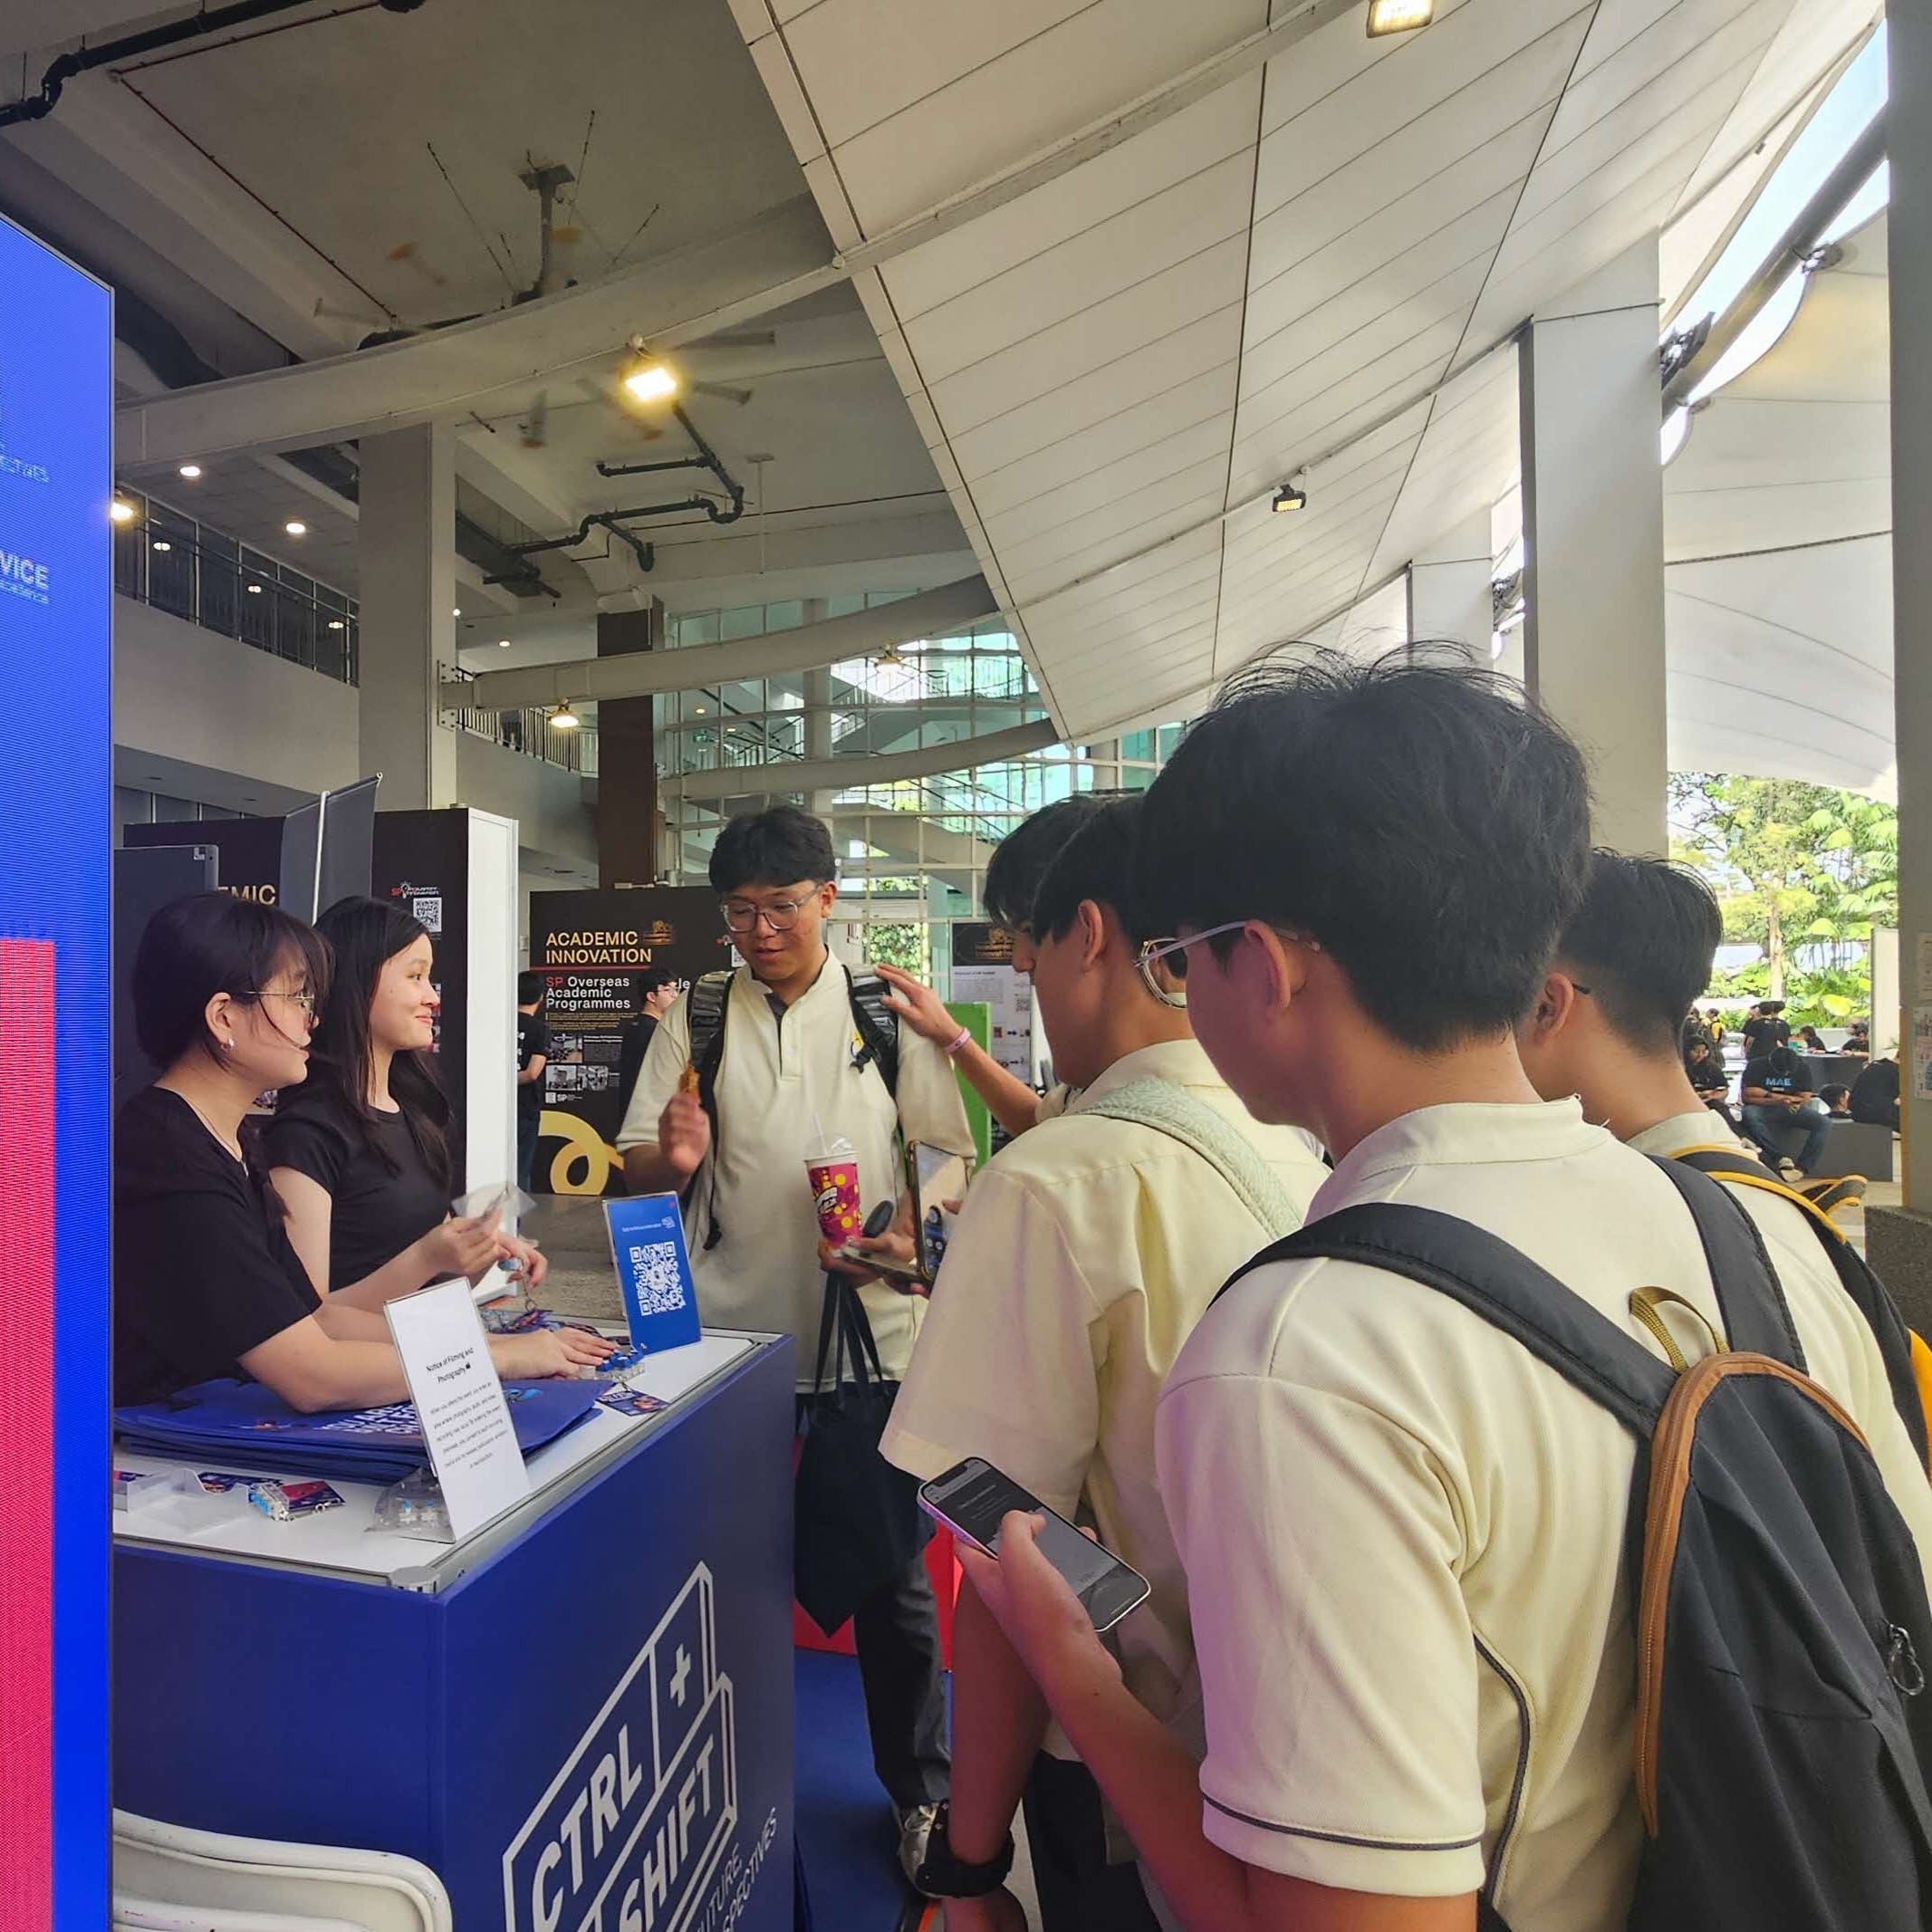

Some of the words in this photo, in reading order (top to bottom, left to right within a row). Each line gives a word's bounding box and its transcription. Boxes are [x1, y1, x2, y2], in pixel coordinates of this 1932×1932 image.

[217, 884, 276, 905] MIC
[546, 931, 639, 947] ACADEMIC
[546, 948, 651, 964] INNOVATION
[546, 977, 563, 988] SP
[567, 976, 630, 987] Overseas
[546, 986, 612, 998] Academic
[546, 998, 631, 1012] Programmes
[1765, 1077, 1793, 1087] MAE
[533, 1724, 642, 1932] CTRL
[619, 1733, 714, 1932] SHIFT
